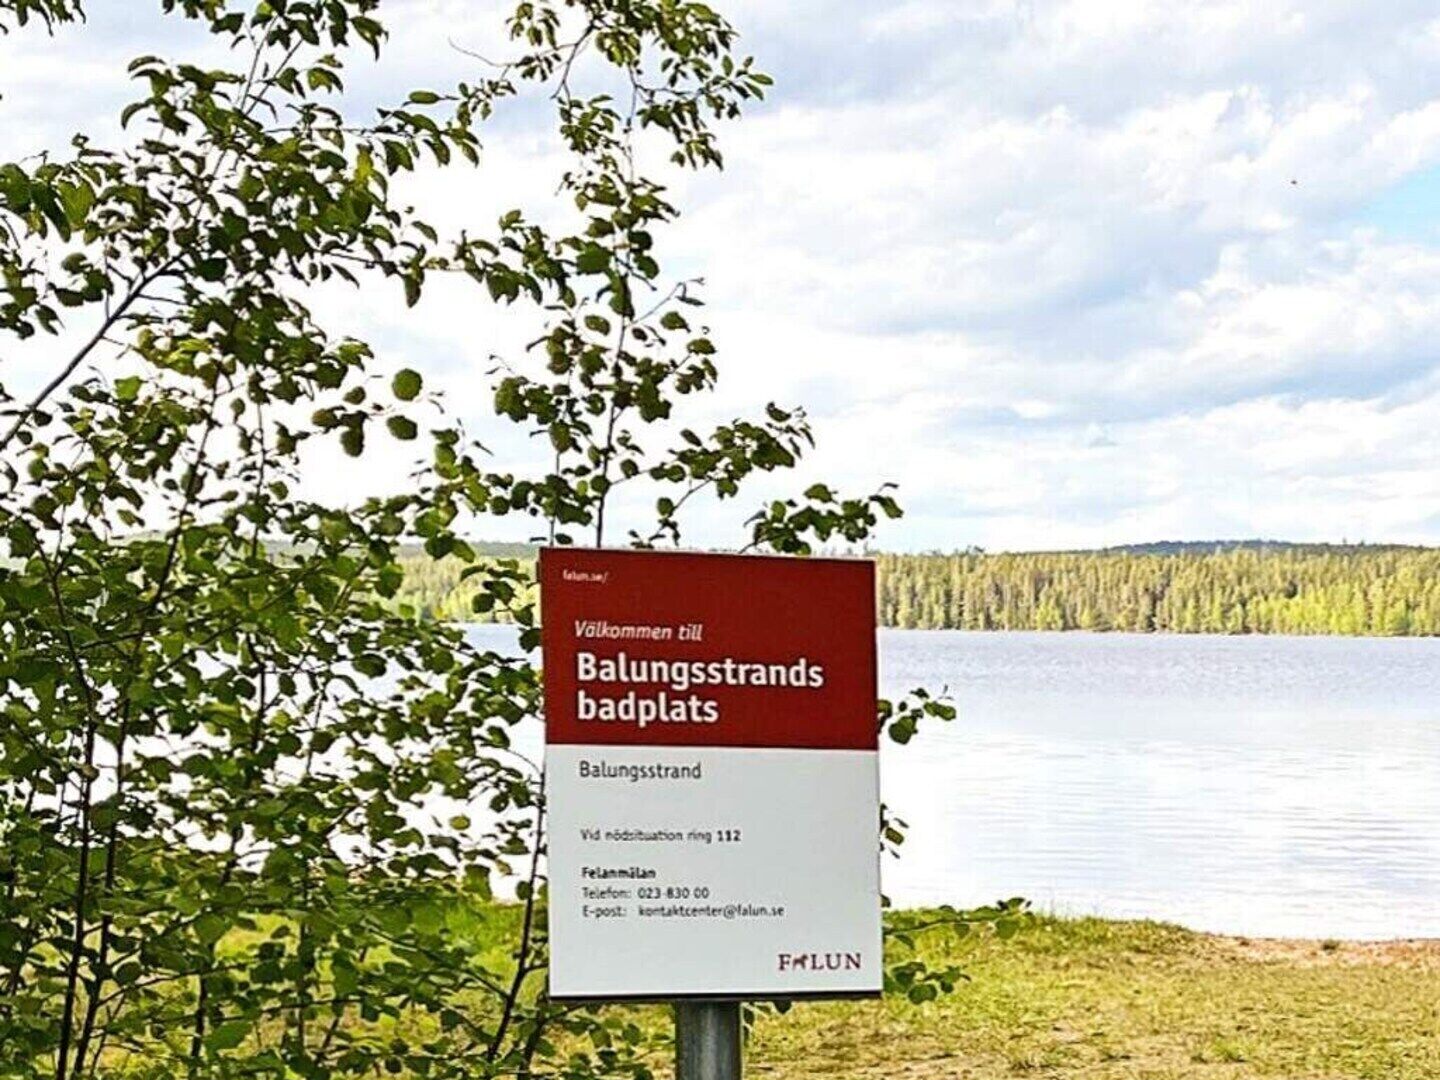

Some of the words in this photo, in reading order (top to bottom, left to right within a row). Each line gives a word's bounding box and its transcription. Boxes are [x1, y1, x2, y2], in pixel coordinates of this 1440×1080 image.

[575, 620, 672, 640] Välkommen
[678, 623, 702, 641] till
[577, 652, 824, 690] Balungsstrands
[577, 690, 719, 727] badplats
[579, 760, 702, 782] Balungsstrand
[580, 829, 601, 842] Vid
[605, 830, 683, 842] nödsituation
[687, 830, 712, 844] ring
[717, 830, 741, 842] 112
[582, 887, 631, 900] Telefon:
[693, 887, 710, 901] 00
[582, 904, 627, 919] E-post:
[638, 903, 784, 919] kontaktcenter@falun.se
